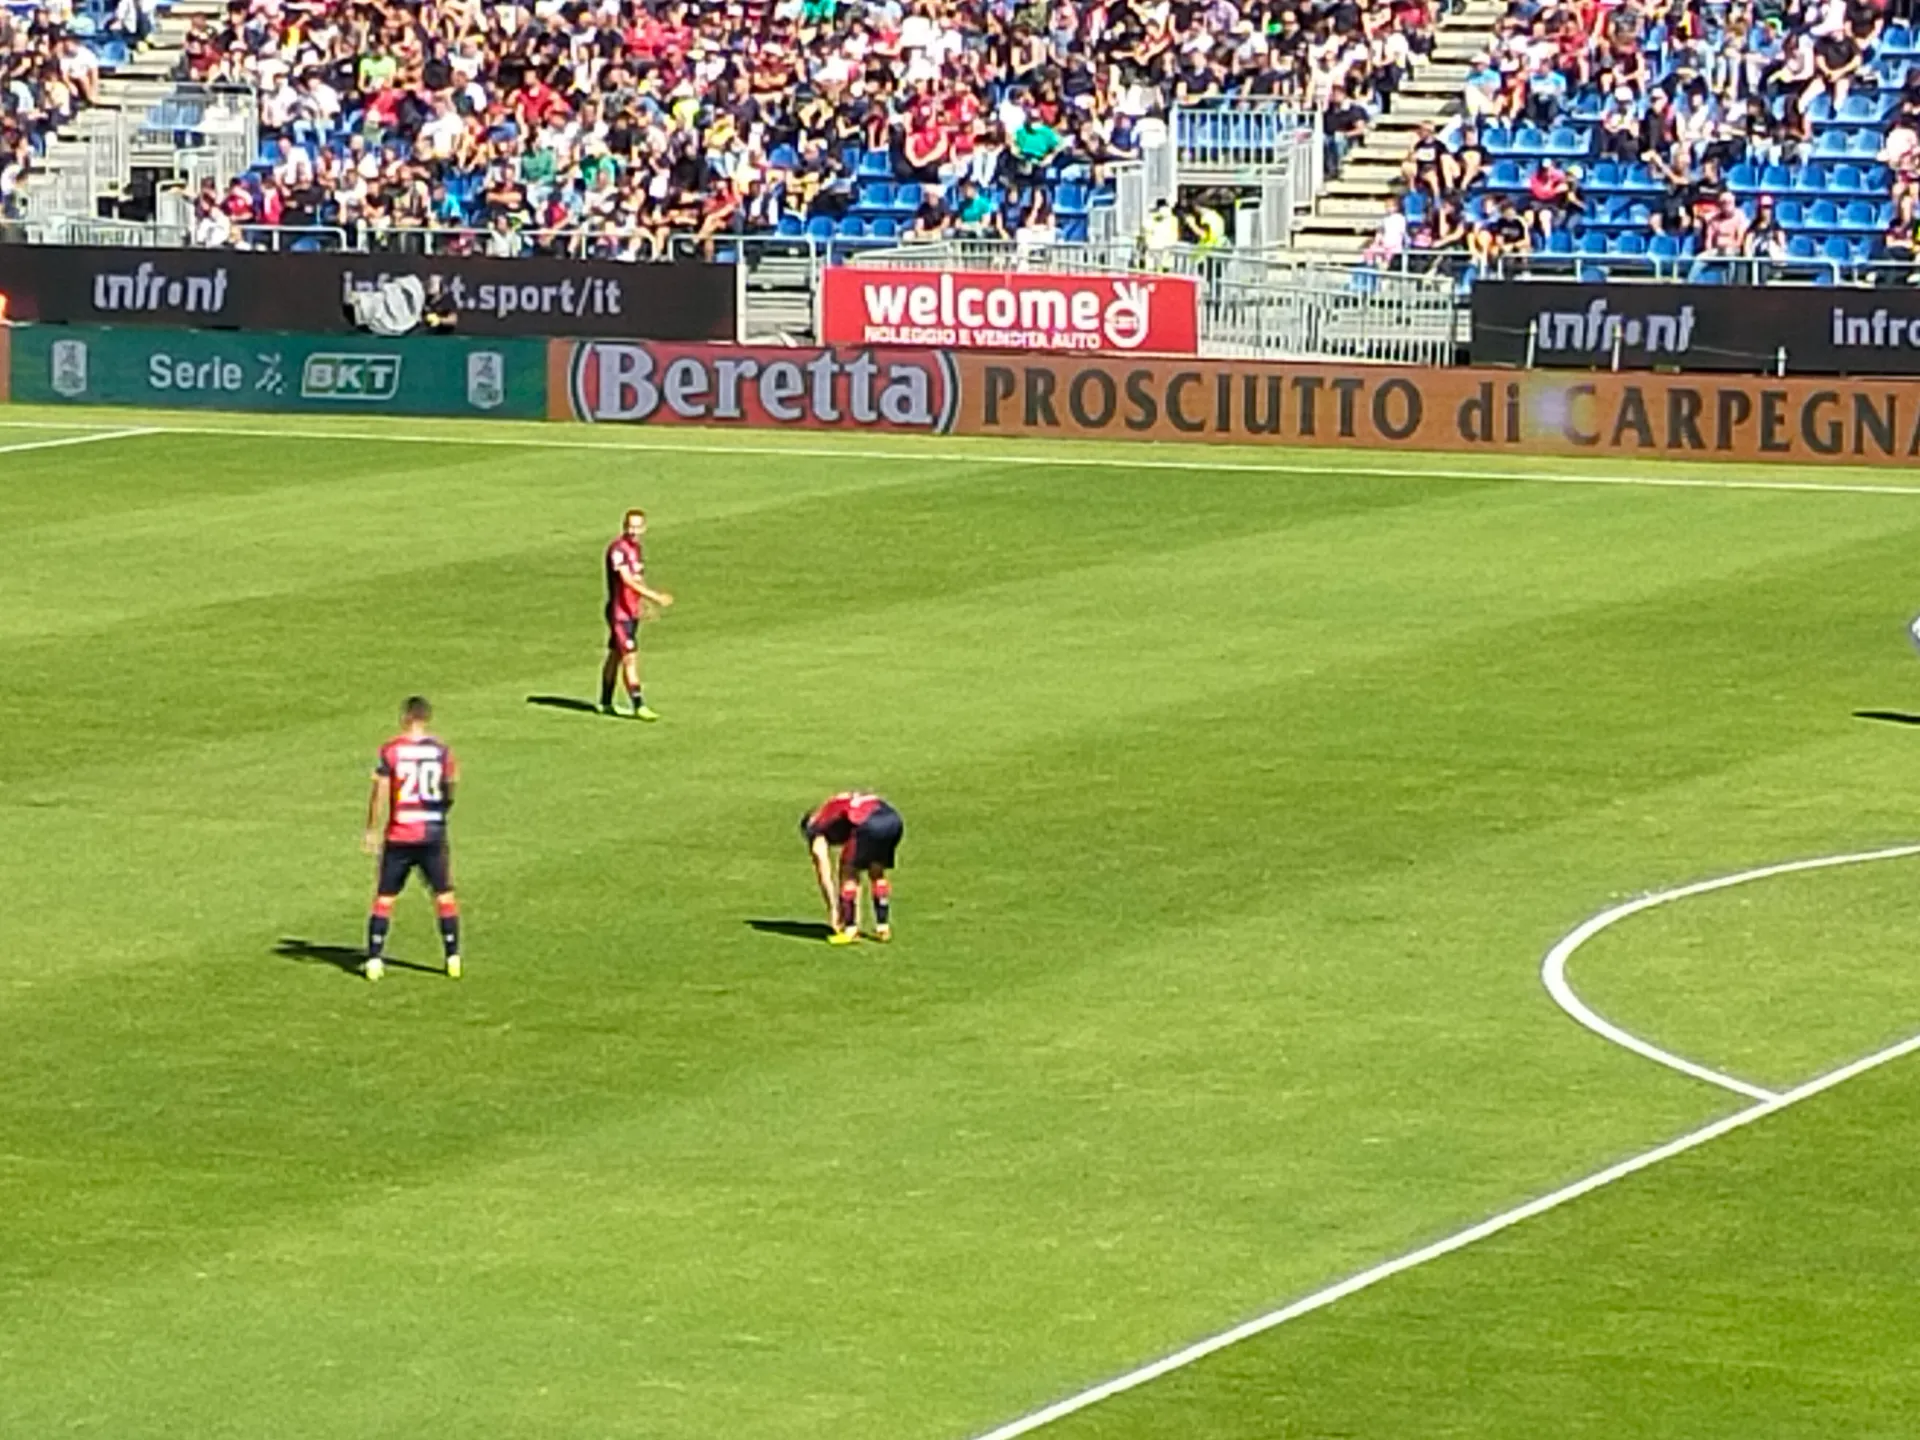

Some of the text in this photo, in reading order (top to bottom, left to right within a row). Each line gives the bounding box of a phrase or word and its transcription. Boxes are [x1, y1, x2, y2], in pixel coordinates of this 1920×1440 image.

[93, 261, 228, 312] infront
[342, 271, 622, 318] it.sport/it
[864, 273, 1100, 330] welcome
[864, 325, 1101, 349] NOLEGGIO E VENDITA AUTO
[1538, 298, 1695, 352] infront
[149, 353, 394, 390] Serie BKT
[593, 343, 934, 425] Beretta
[982, 365, 1920, 457] PROSCIUTTO di CARPEGN
[396, 760, 443, 804] 20
